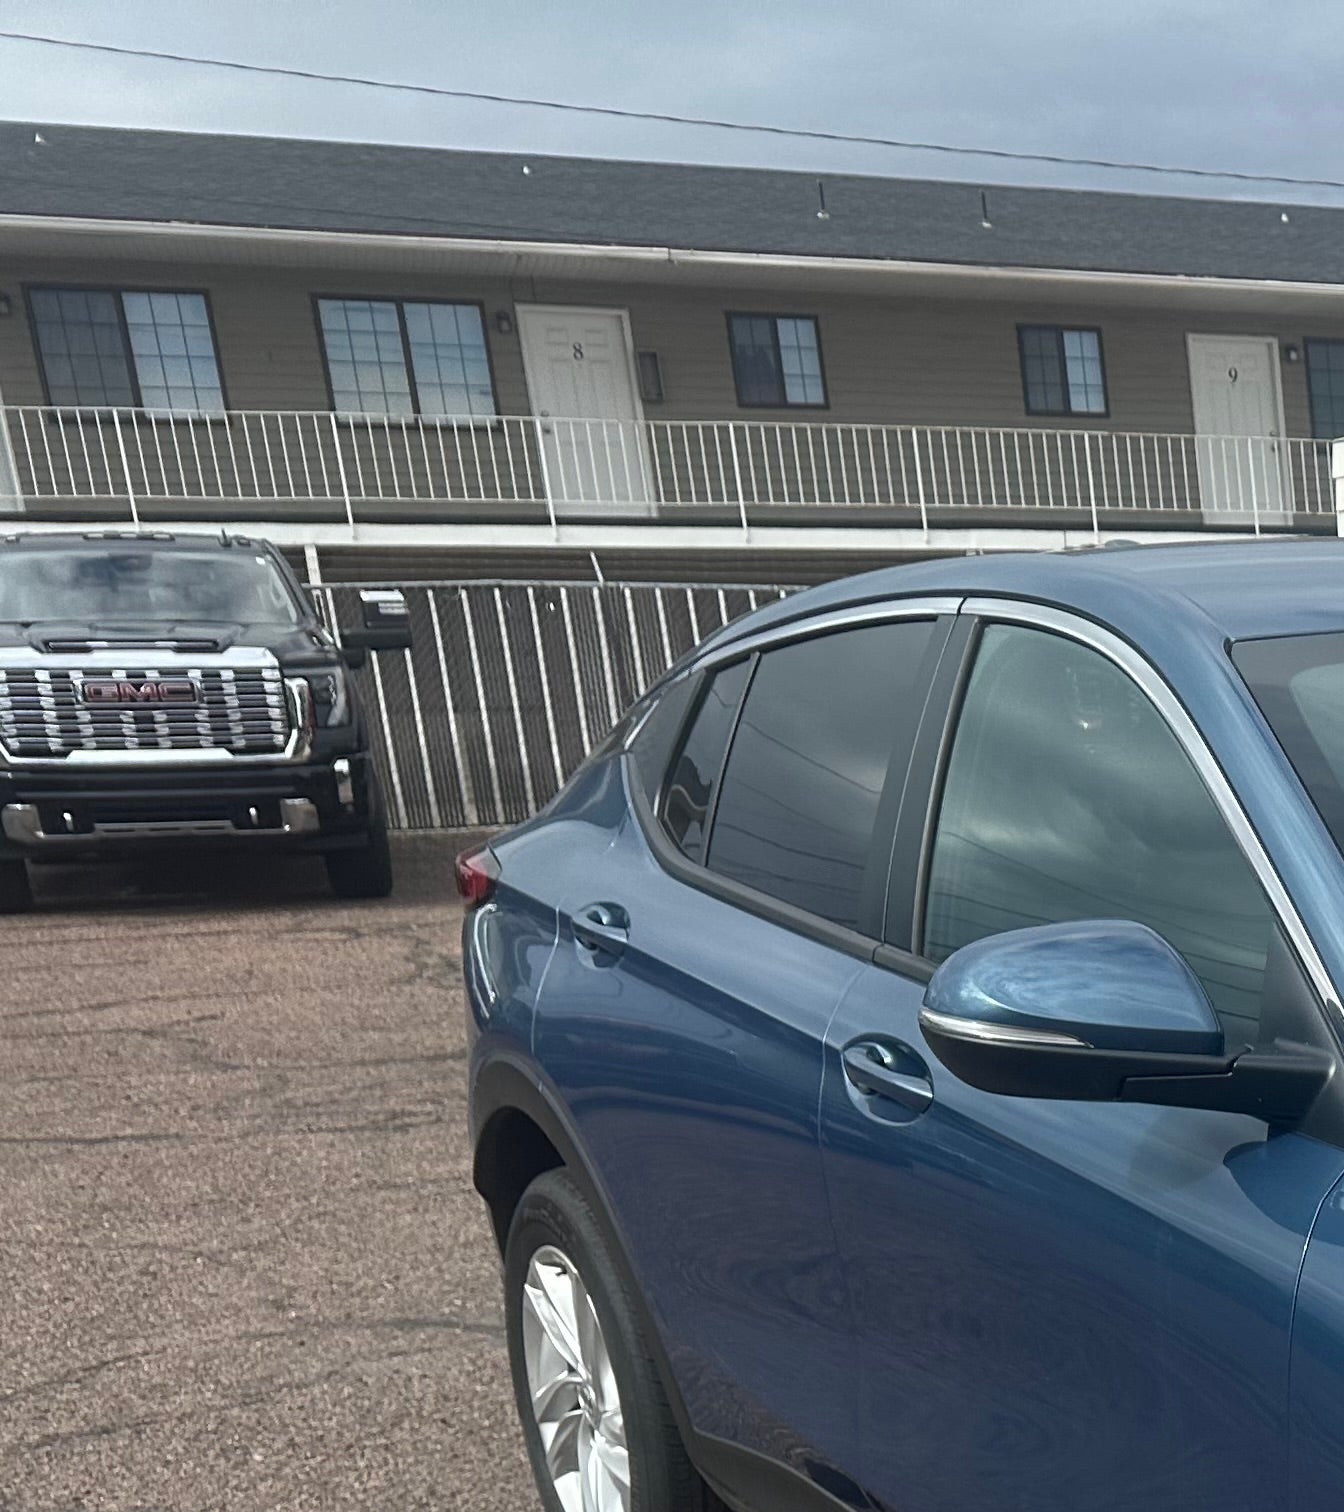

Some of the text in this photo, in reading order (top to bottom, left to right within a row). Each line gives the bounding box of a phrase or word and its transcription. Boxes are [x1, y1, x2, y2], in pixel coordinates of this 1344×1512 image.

[572, 341, 584, 361] 8
[1228, 366, 1238, 382] 9
[83, 682, 196, 702] GMC
